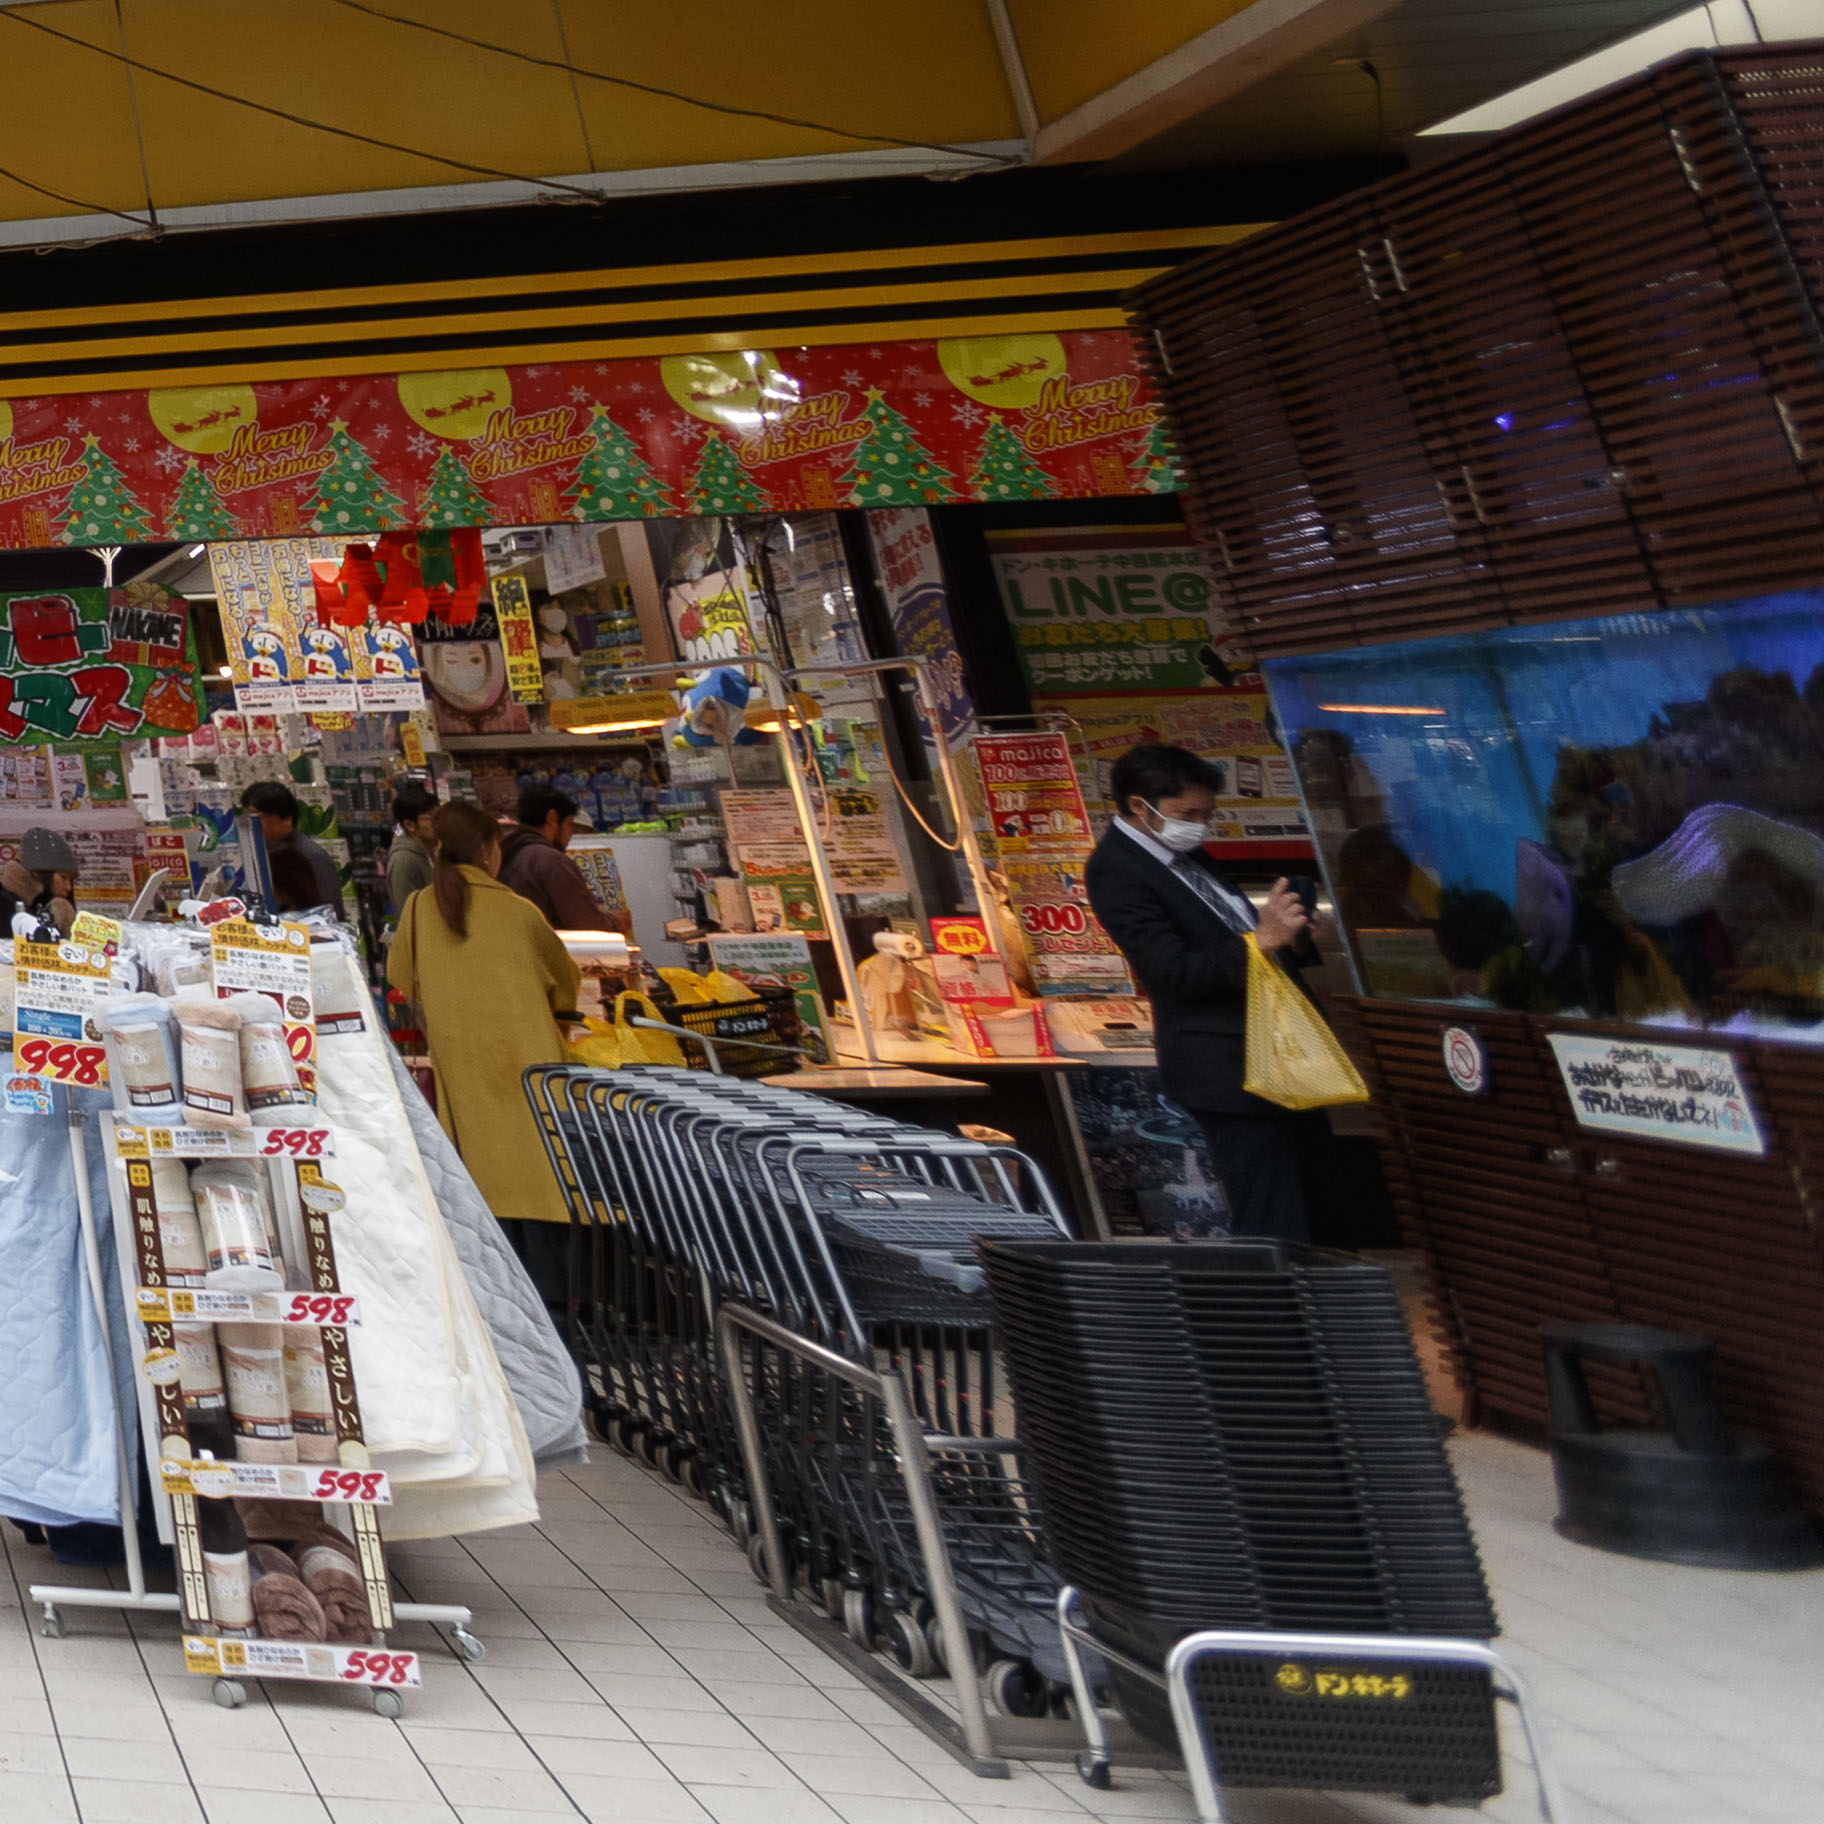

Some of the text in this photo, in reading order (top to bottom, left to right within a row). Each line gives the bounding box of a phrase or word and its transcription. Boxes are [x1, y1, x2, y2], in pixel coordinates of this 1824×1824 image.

[757, 391, 849, 429] Merry
[1028, 377, 1138, 420] Merry
[227, 422, 315, 463] Merry
[480, 406, 574, 450] Merry
[739, 420, 873, 469] Christmas
[1022, 405, 1159, 454] Christmas
[214, 451, 336, 495] Christmas
[467, 435, 598, 482] Christmas
[1007, 573, 1210, 619] LINE@
[1001, 748, 1063, 762] majica
[943, 930, 988, 948] 無料
[20, 1039, 107, 1085] 998
[263, 1129, 329, 1157] 598
[289, 1296, 356, 1324] 598
[150, 1321, 183, 1426] やしい
[321, 1327, 360, 1427] やさしい
[314, 1469, 385, 1499] 598
[342, 1650, 415, 1684] 598
